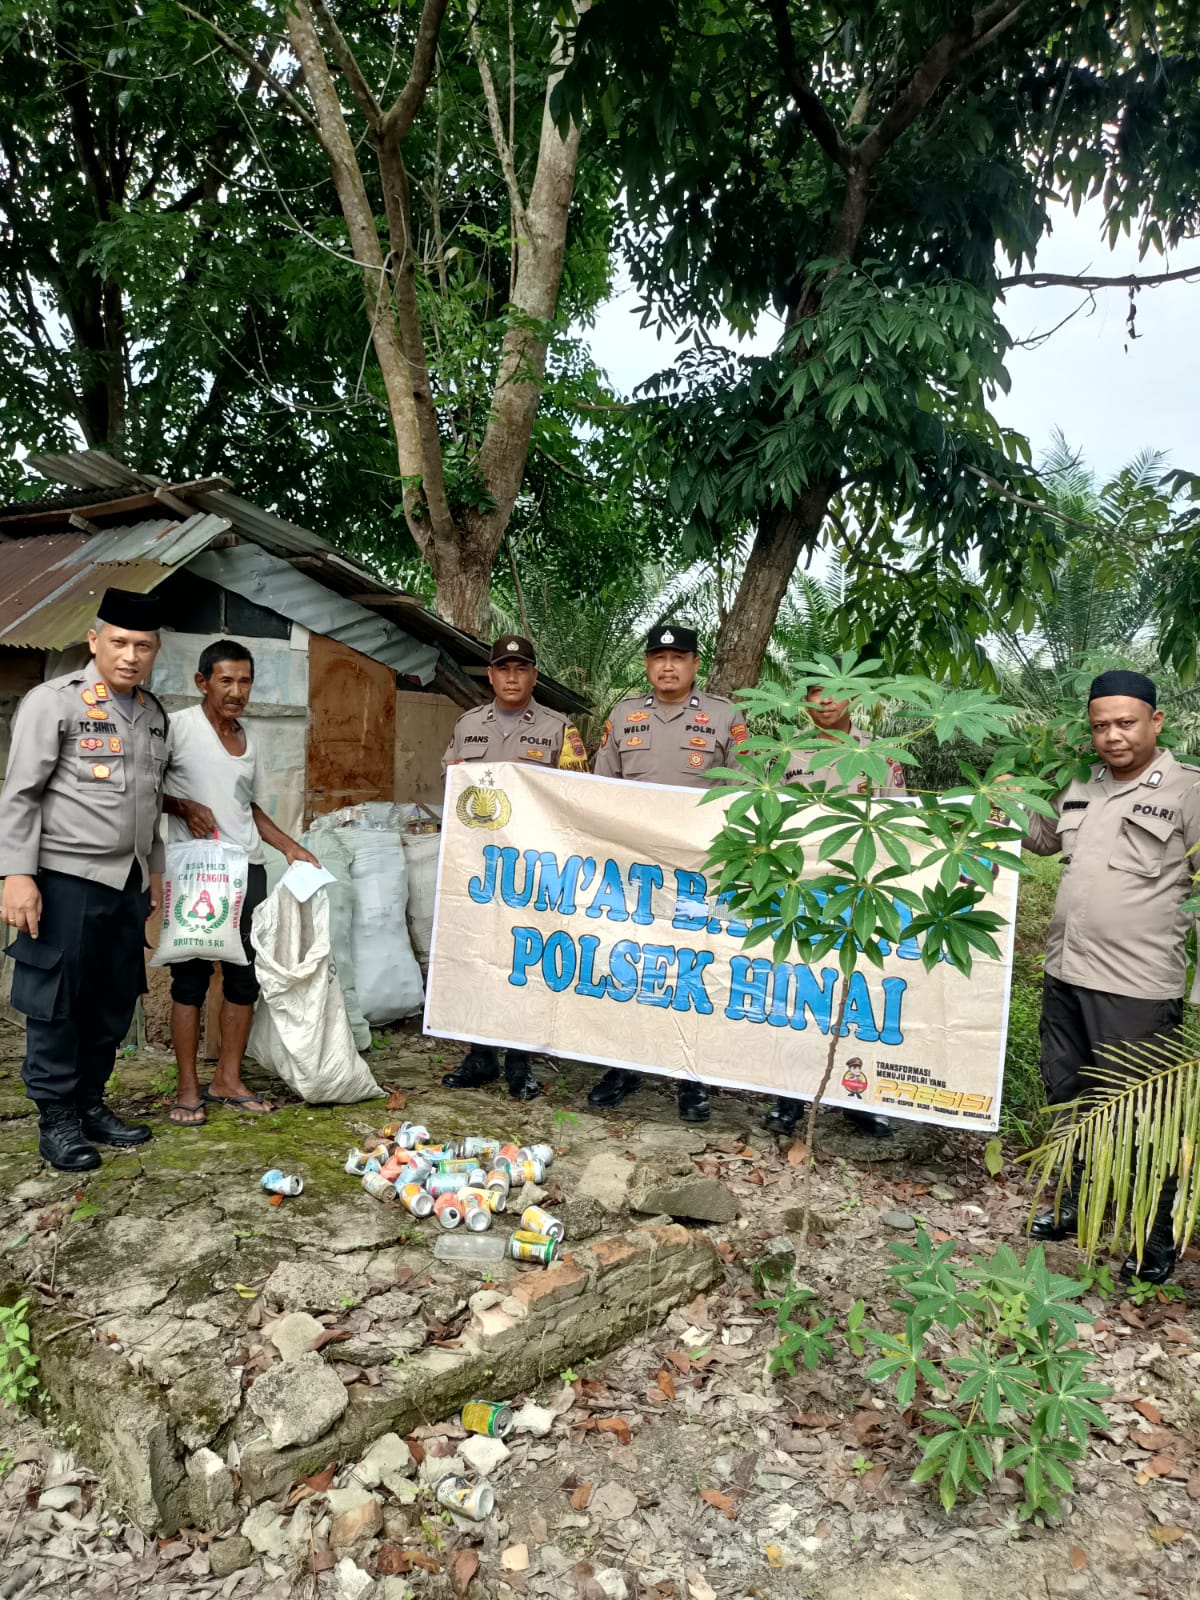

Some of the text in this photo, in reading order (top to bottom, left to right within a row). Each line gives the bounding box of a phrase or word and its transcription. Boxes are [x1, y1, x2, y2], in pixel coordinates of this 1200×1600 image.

[79, 721, 91, 732] TC
[623, 725, 650, 734] WELDI
[685, 724, 716, 735] POLRI
[520, 736, 552, 746] POLRI
[1132, 803, 1175, 821] POLRI
[468, 844, 664, 926] JUM'AT
[508, 926, 907, 1045] POLSEK HINAI
[876, 1061, 931, 1076] TRANSFORMASI
[876, 1070, 947, 1088] MENUJU POLRI YANG
[875, 1079, 993, 1112] PRESISI
